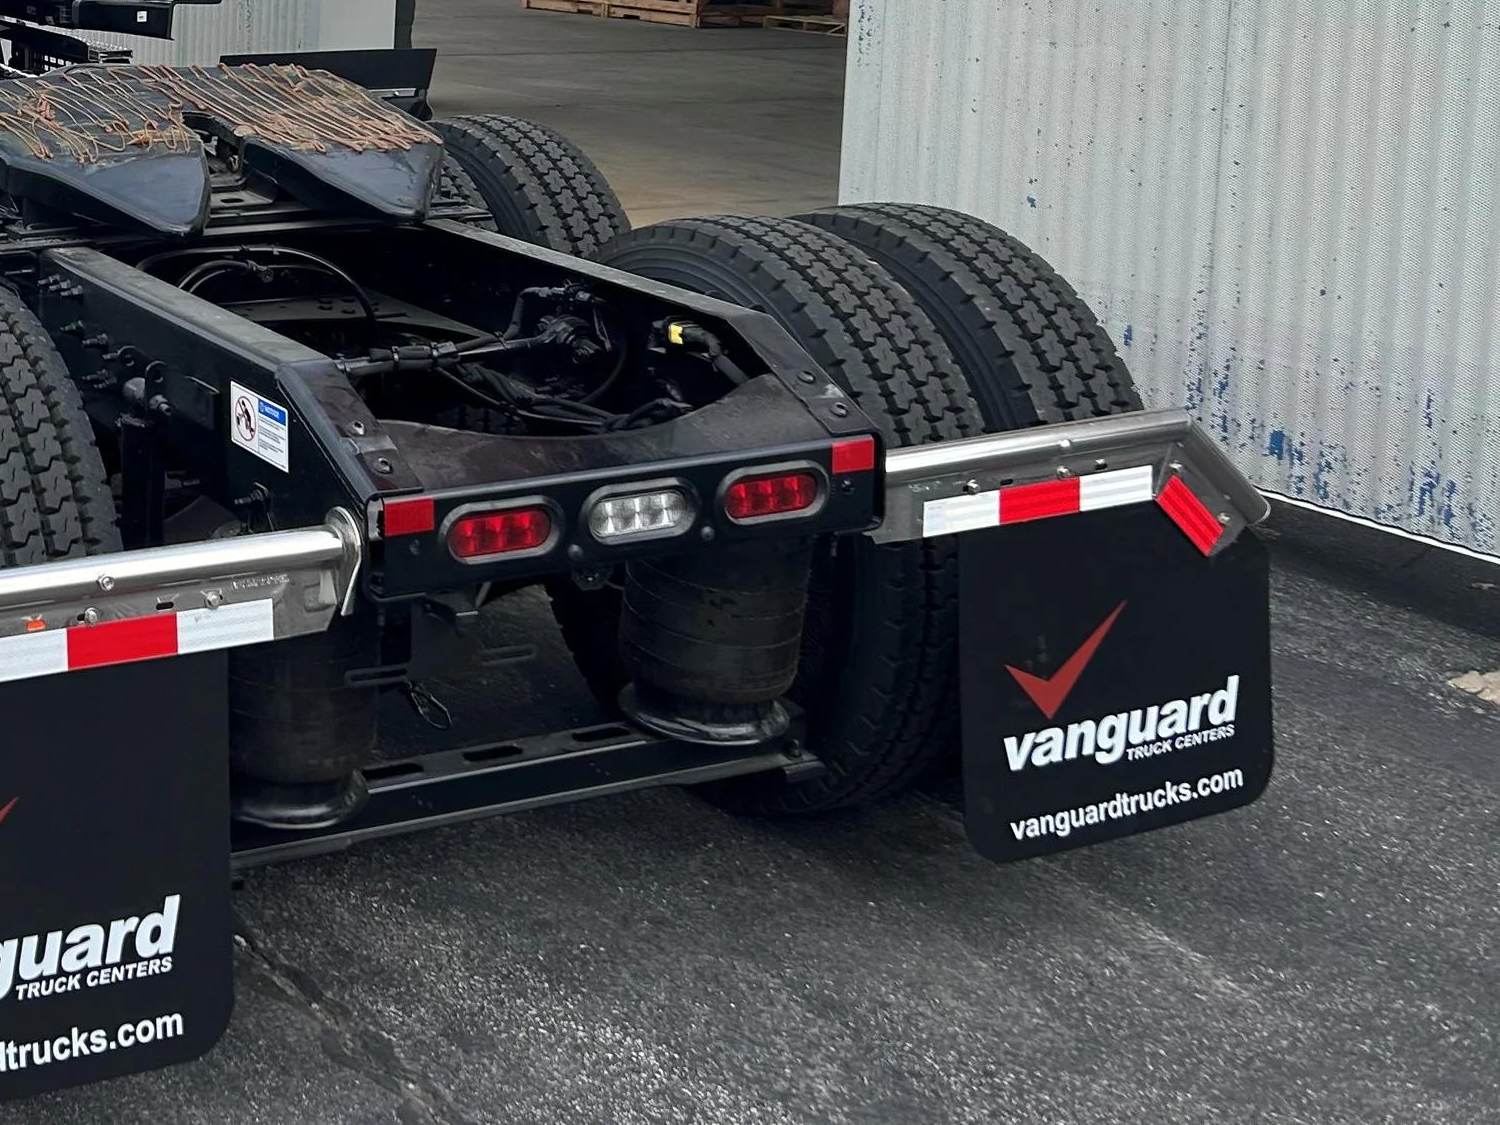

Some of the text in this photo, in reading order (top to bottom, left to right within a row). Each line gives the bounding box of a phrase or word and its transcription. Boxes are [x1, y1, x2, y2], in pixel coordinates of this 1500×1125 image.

[1003, 674, 1240, 771] vanguard
[1126, 724, 1235, 761] TRUCK CENTERS
[1010, 768, 1244, 840] vanguardtrucks.com
[15, 955, 173, 1001] TRUCK CENTERS
